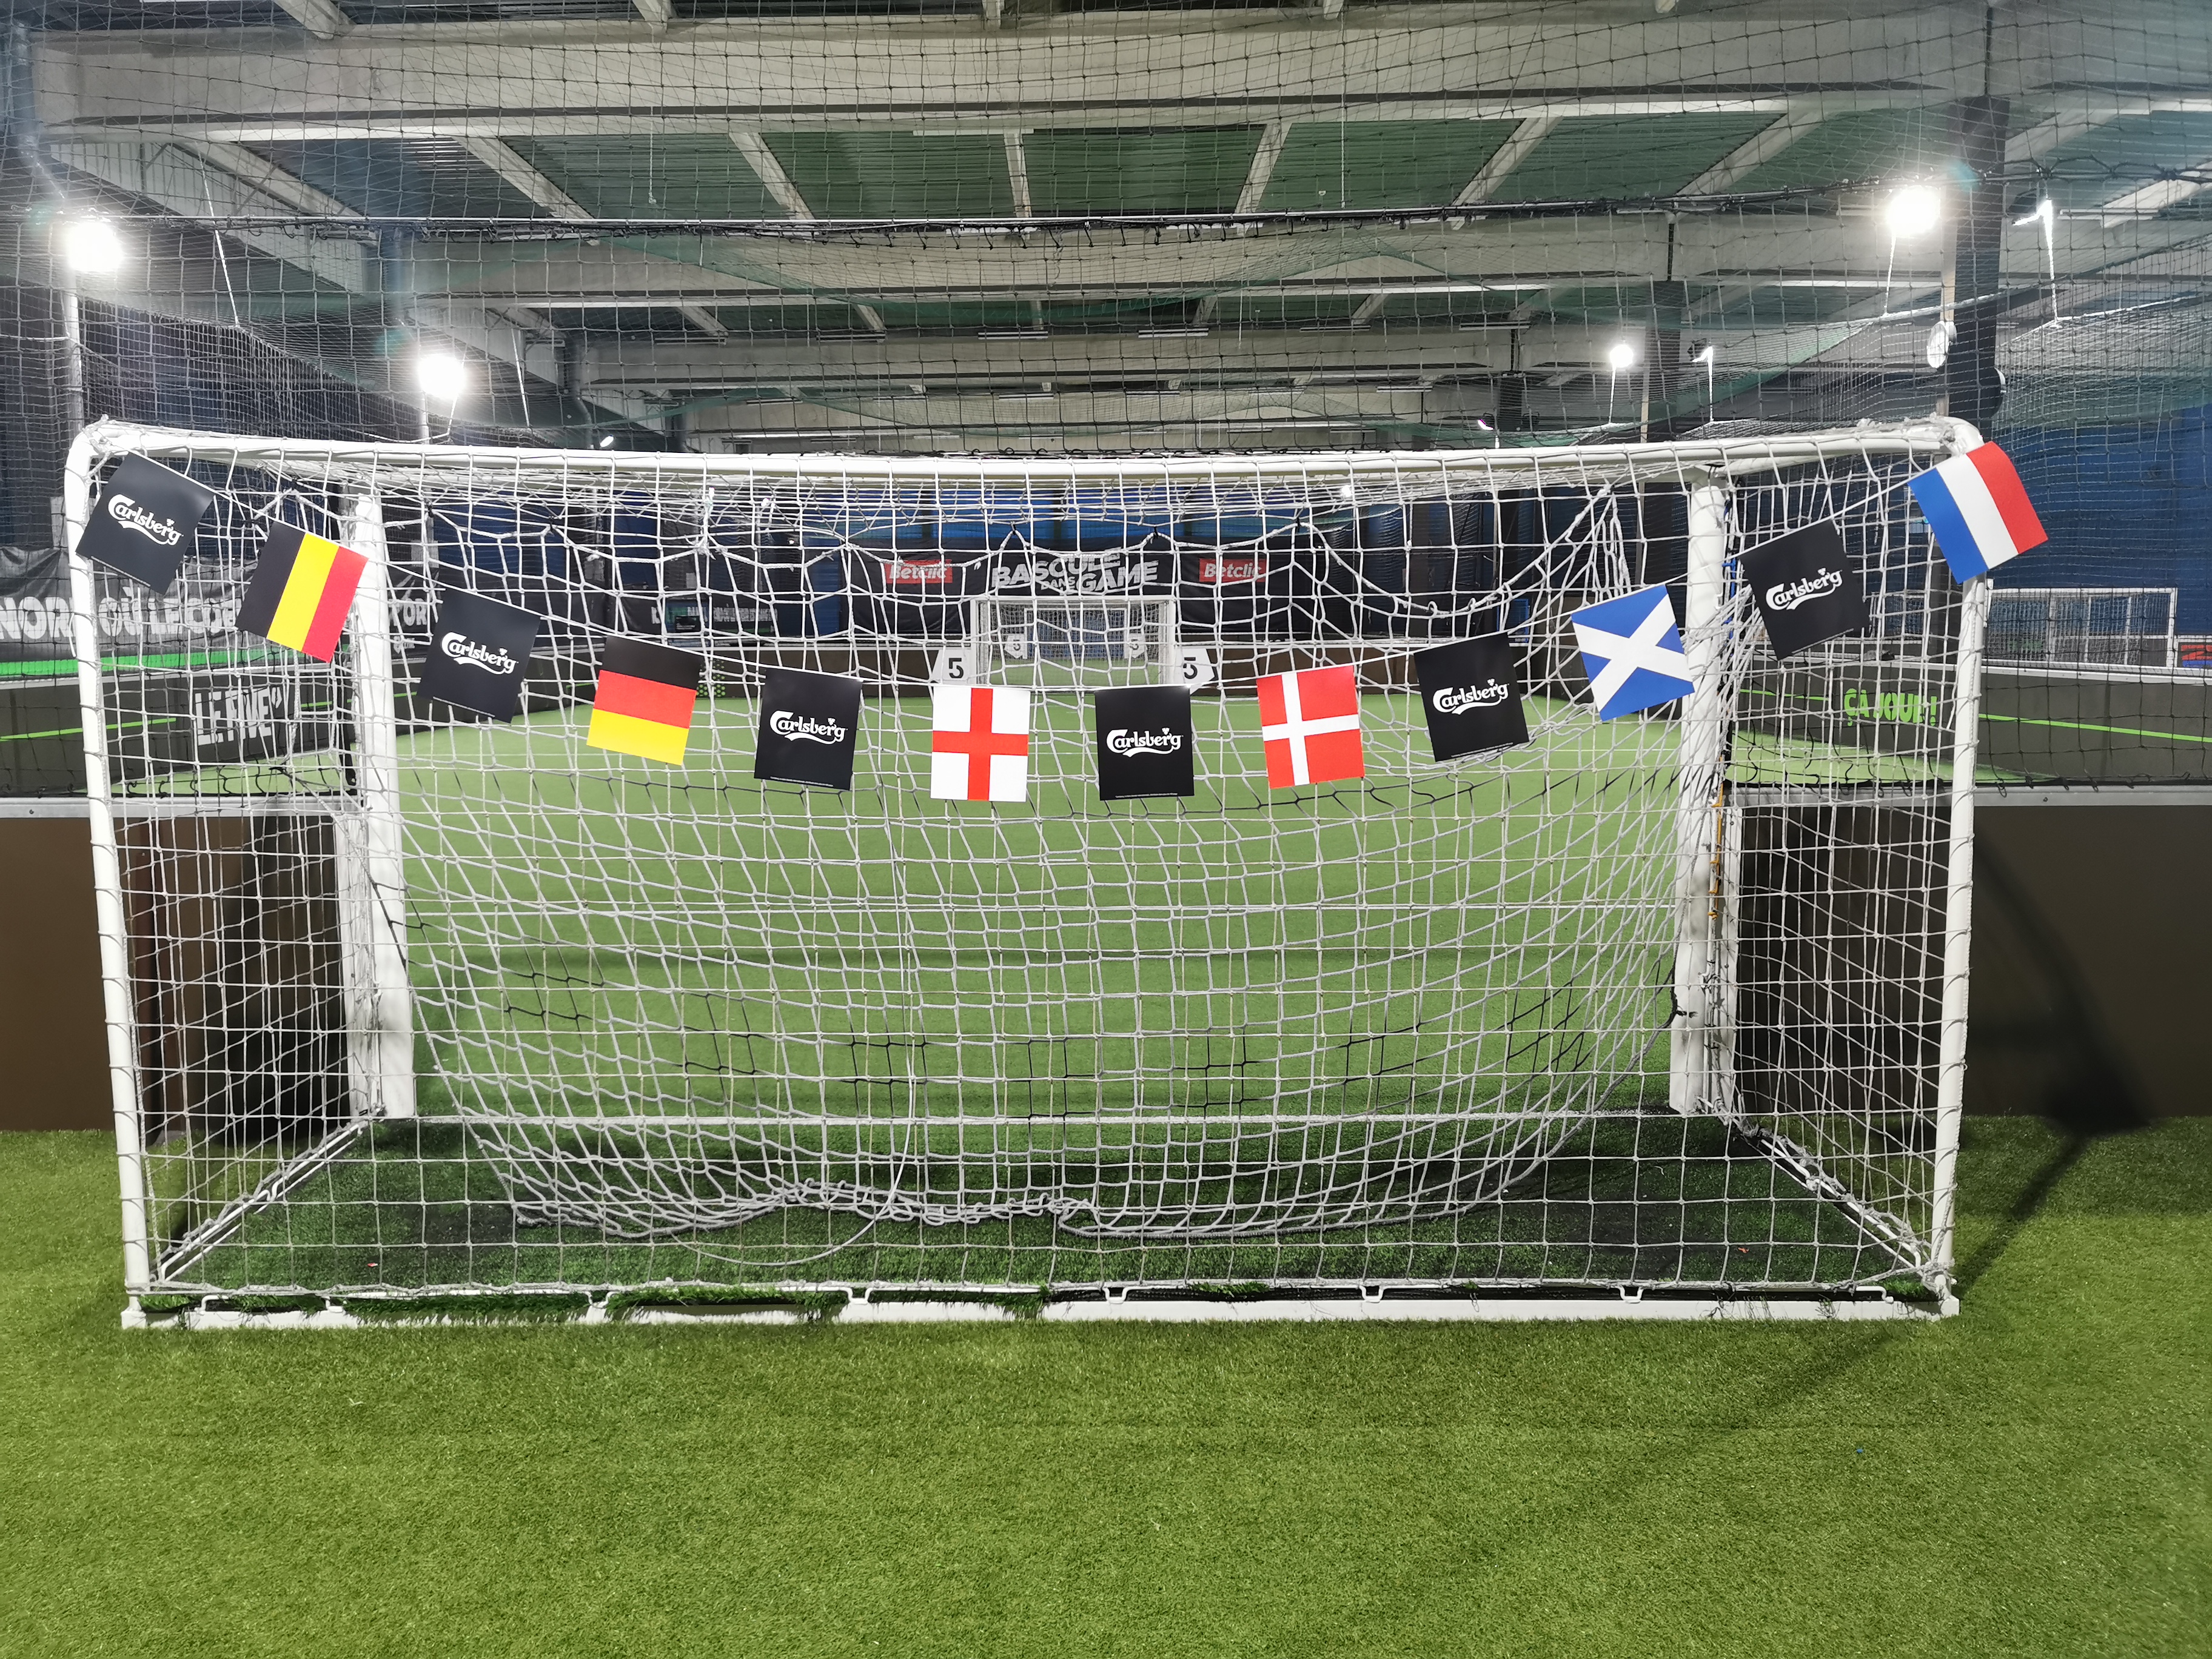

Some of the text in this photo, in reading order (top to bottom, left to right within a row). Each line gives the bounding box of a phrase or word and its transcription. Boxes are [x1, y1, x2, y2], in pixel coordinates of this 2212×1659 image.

[108, 494, 184, 545] Carlsberg
[1076, 560, 1159, 592] GAME
[1765, 569, 1843, 611] Carlsberg
[0, 596, 76, 640] NOR
[441, 631, 519, 675] Carlsberg
[948, 657, 964, 679] 5
[1182, 657, 1198, 679] 5
[1432, 679, 1510, 715] Carlsberg
[769, 709, 848, 745] Carlsberg
[1106, 728, 1184, 757] Carlsberg
